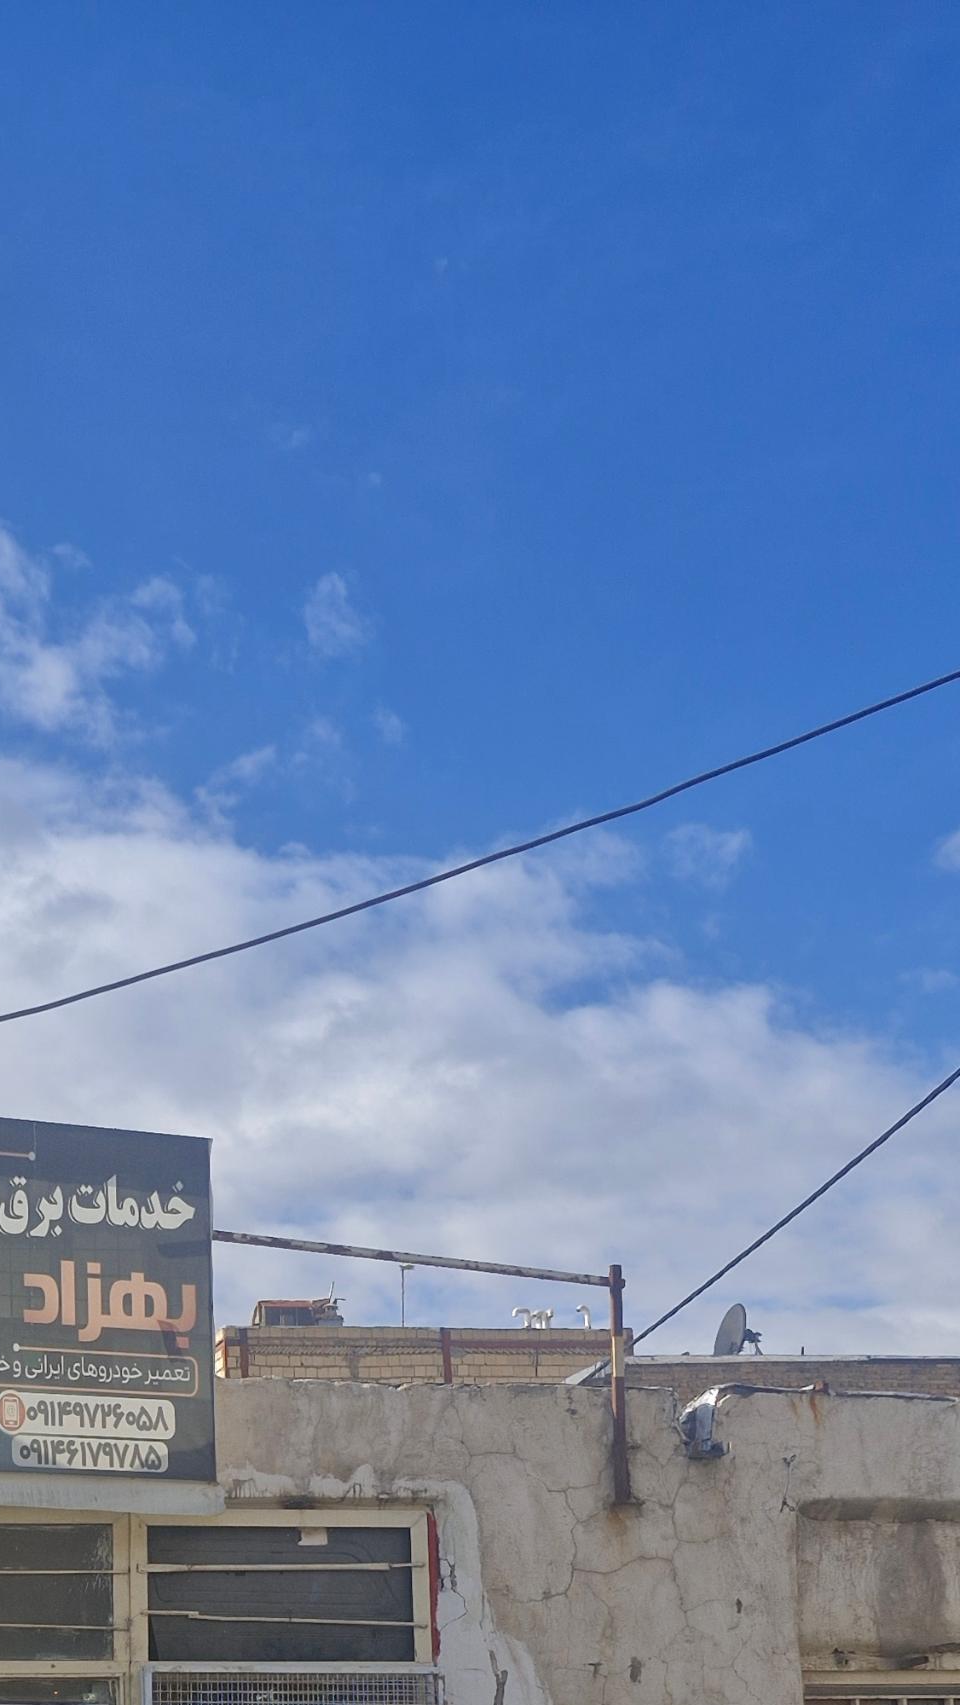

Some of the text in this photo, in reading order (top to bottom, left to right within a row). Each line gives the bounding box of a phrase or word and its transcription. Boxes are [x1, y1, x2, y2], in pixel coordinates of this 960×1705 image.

[69, 1174, 196, 1231] خدمات
[23, 1259, 197, 1350] بهزاد
[24, 1354, 64, 1381] ایرانی
[67, 1356, 142, 1384] خودروهای
[144, 1366, 190, 1385] تعمیر
[26, 1399, 170, 1432] ۰۹۱۴۹۷۲۶۰۵۸
